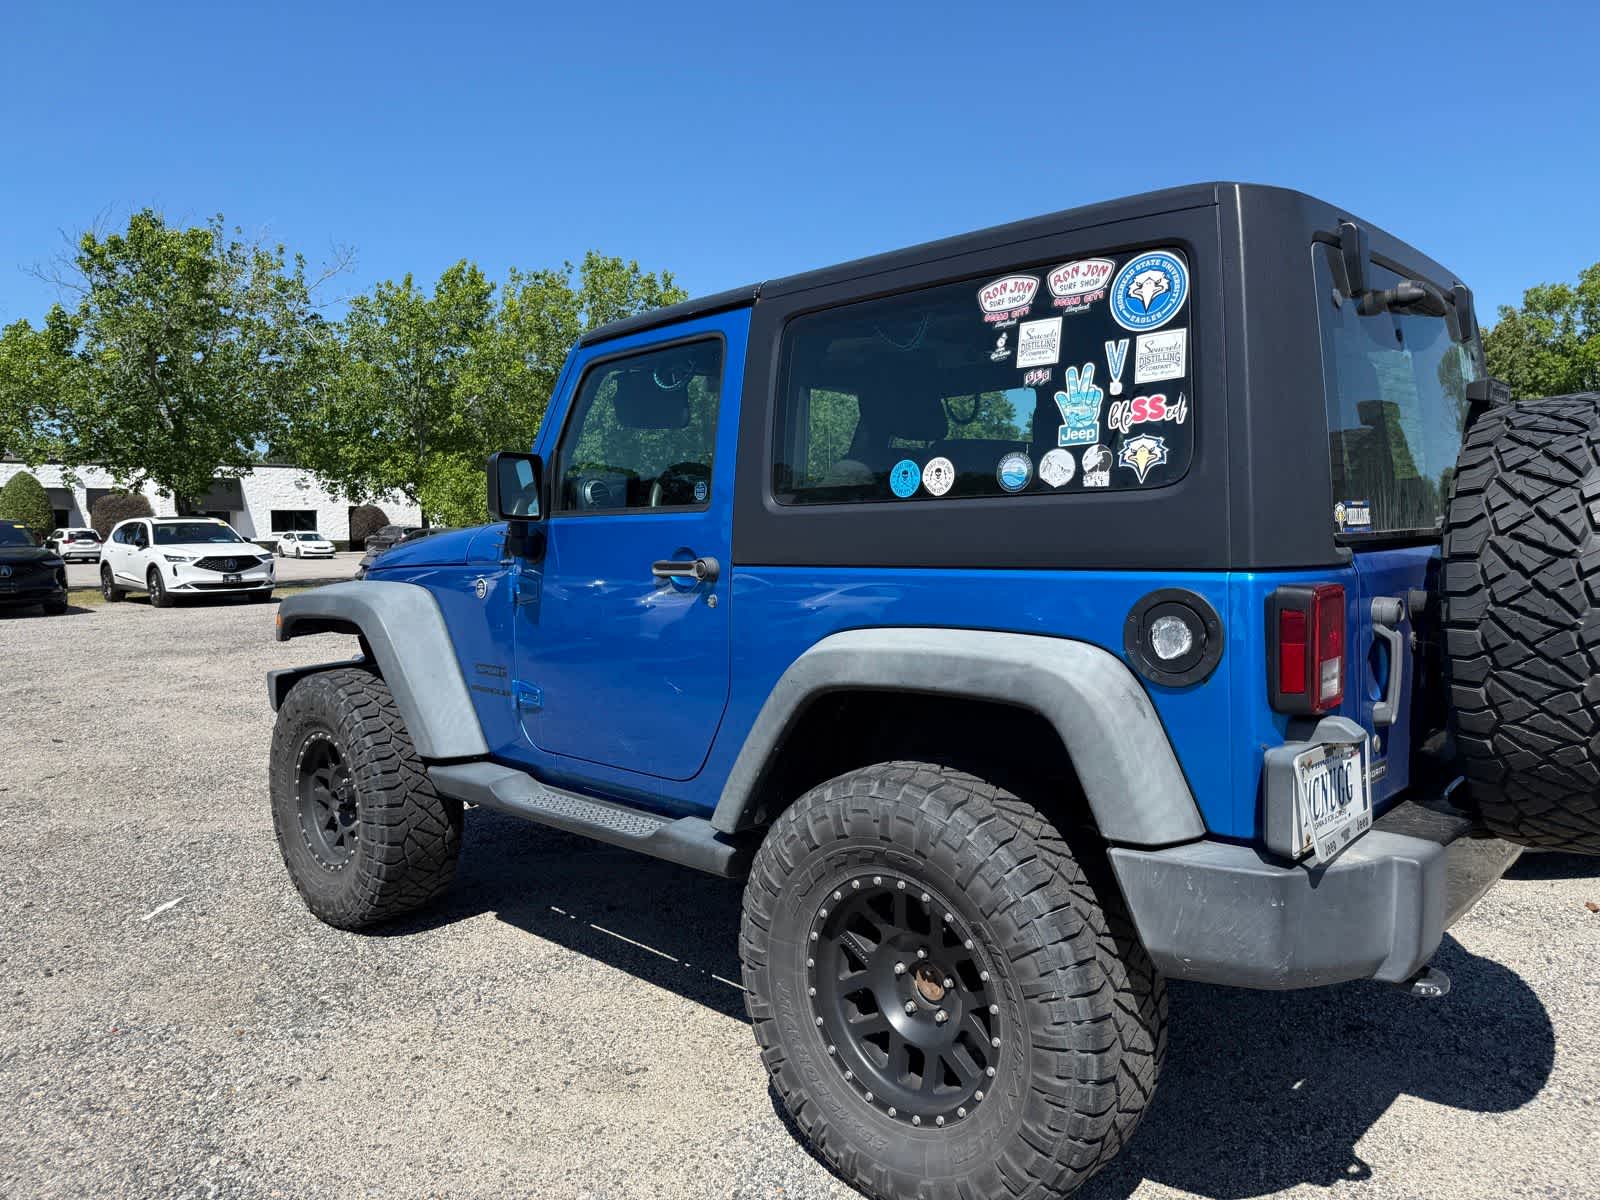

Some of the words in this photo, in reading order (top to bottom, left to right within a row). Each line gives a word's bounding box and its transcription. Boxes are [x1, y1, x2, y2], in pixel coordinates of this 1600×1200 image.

[1135, 259, 1161, 271] STATE
[1054, 265, 1080, 286] RON
[1082, 264, 1109, 277] JON
[1060, 281, 1077, 291] SURF
[1080, 278, 1100, 287] SHOP
[984, 282, 1008, 303] RON
[1009, 281, 1034, 294] JON
[990, 298, 1006, 307] SURF
[1008, 294, 1026, 304] SHOP
[1129, 312, 1162, 324] EAGLES
[1021, 338, 1056, 352] DISTILLING
[1139, 352, 1181, 367] DISTILLING
[1062, 428, 1096, 441] Jeep
[1357, 815, 1369, 832] Jeep
[1325, 839, 1337, 857] Jeep
